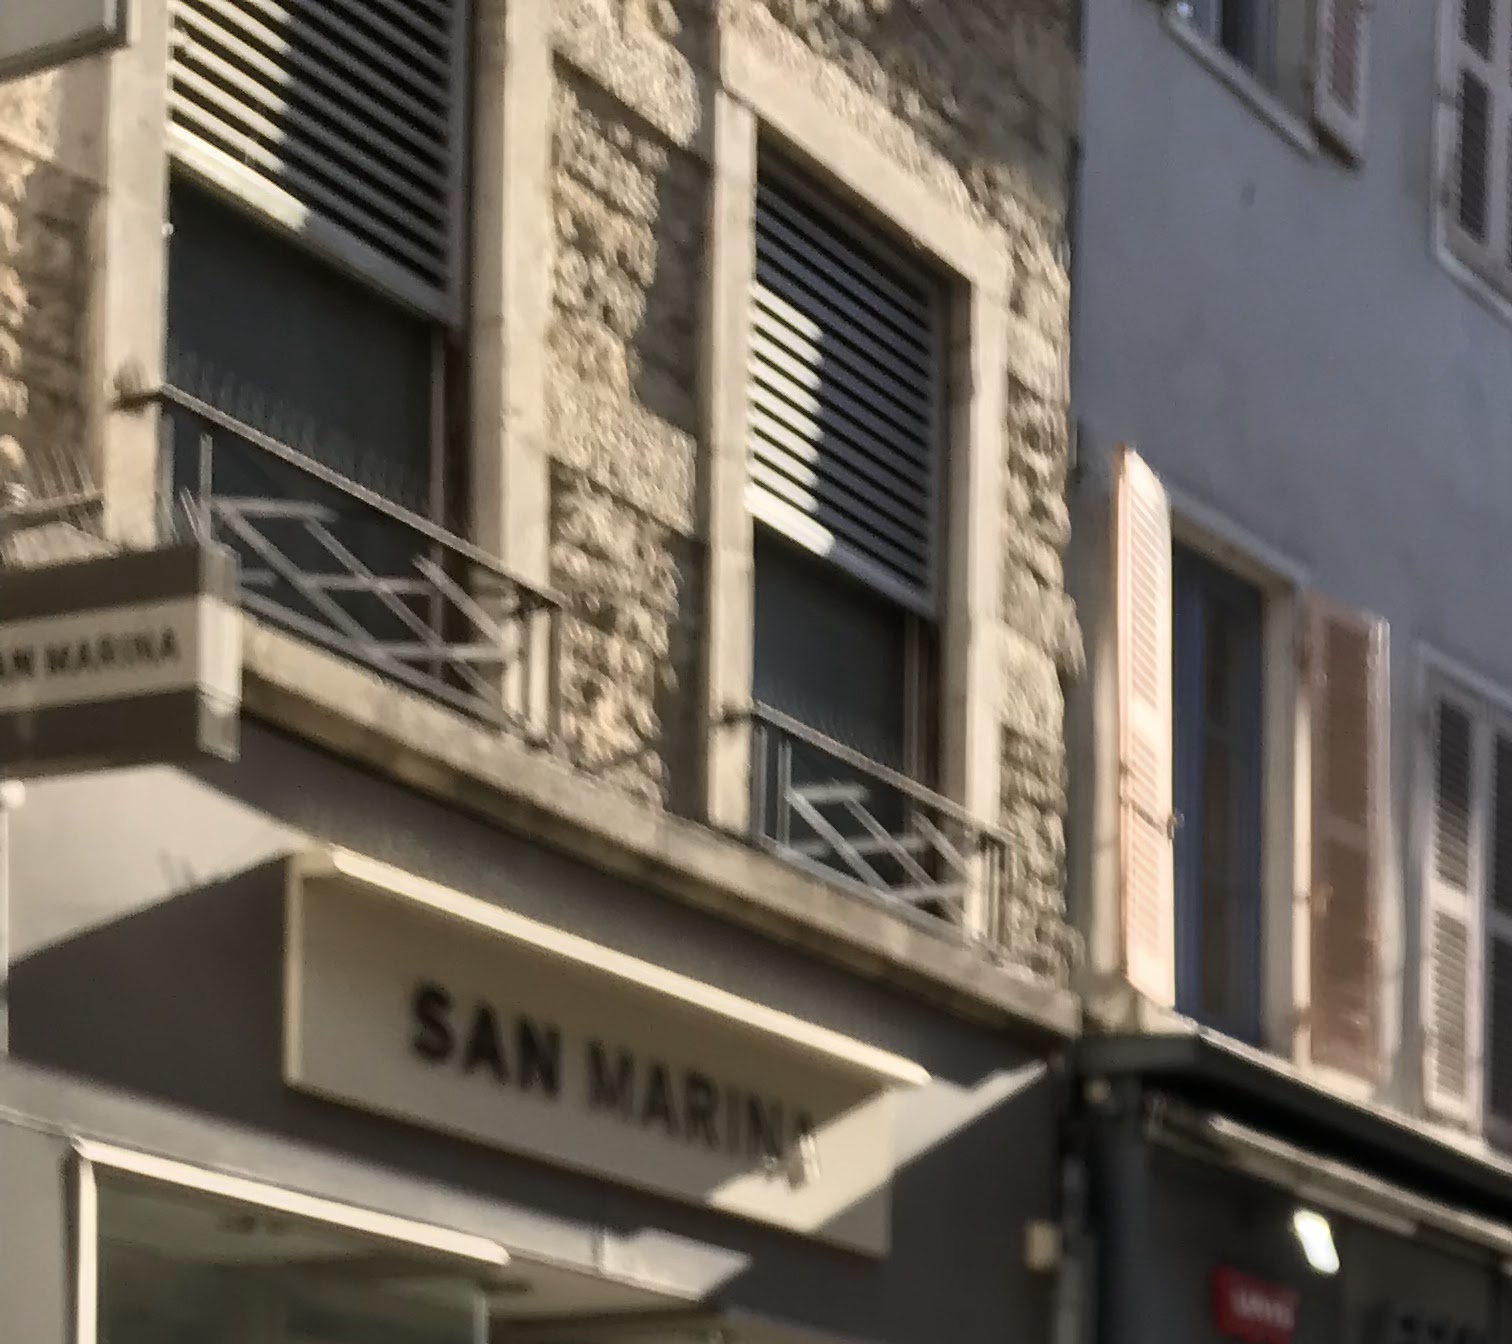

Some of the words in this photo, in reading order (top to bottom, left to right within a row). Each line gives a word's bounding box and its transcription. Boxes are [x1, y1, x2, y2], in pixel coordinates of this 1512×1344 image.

[46, 626, 179, 676] MARINA
[410, 976, 562, 1098] SAN
[585, 1036, 822, 1192] MARINA
